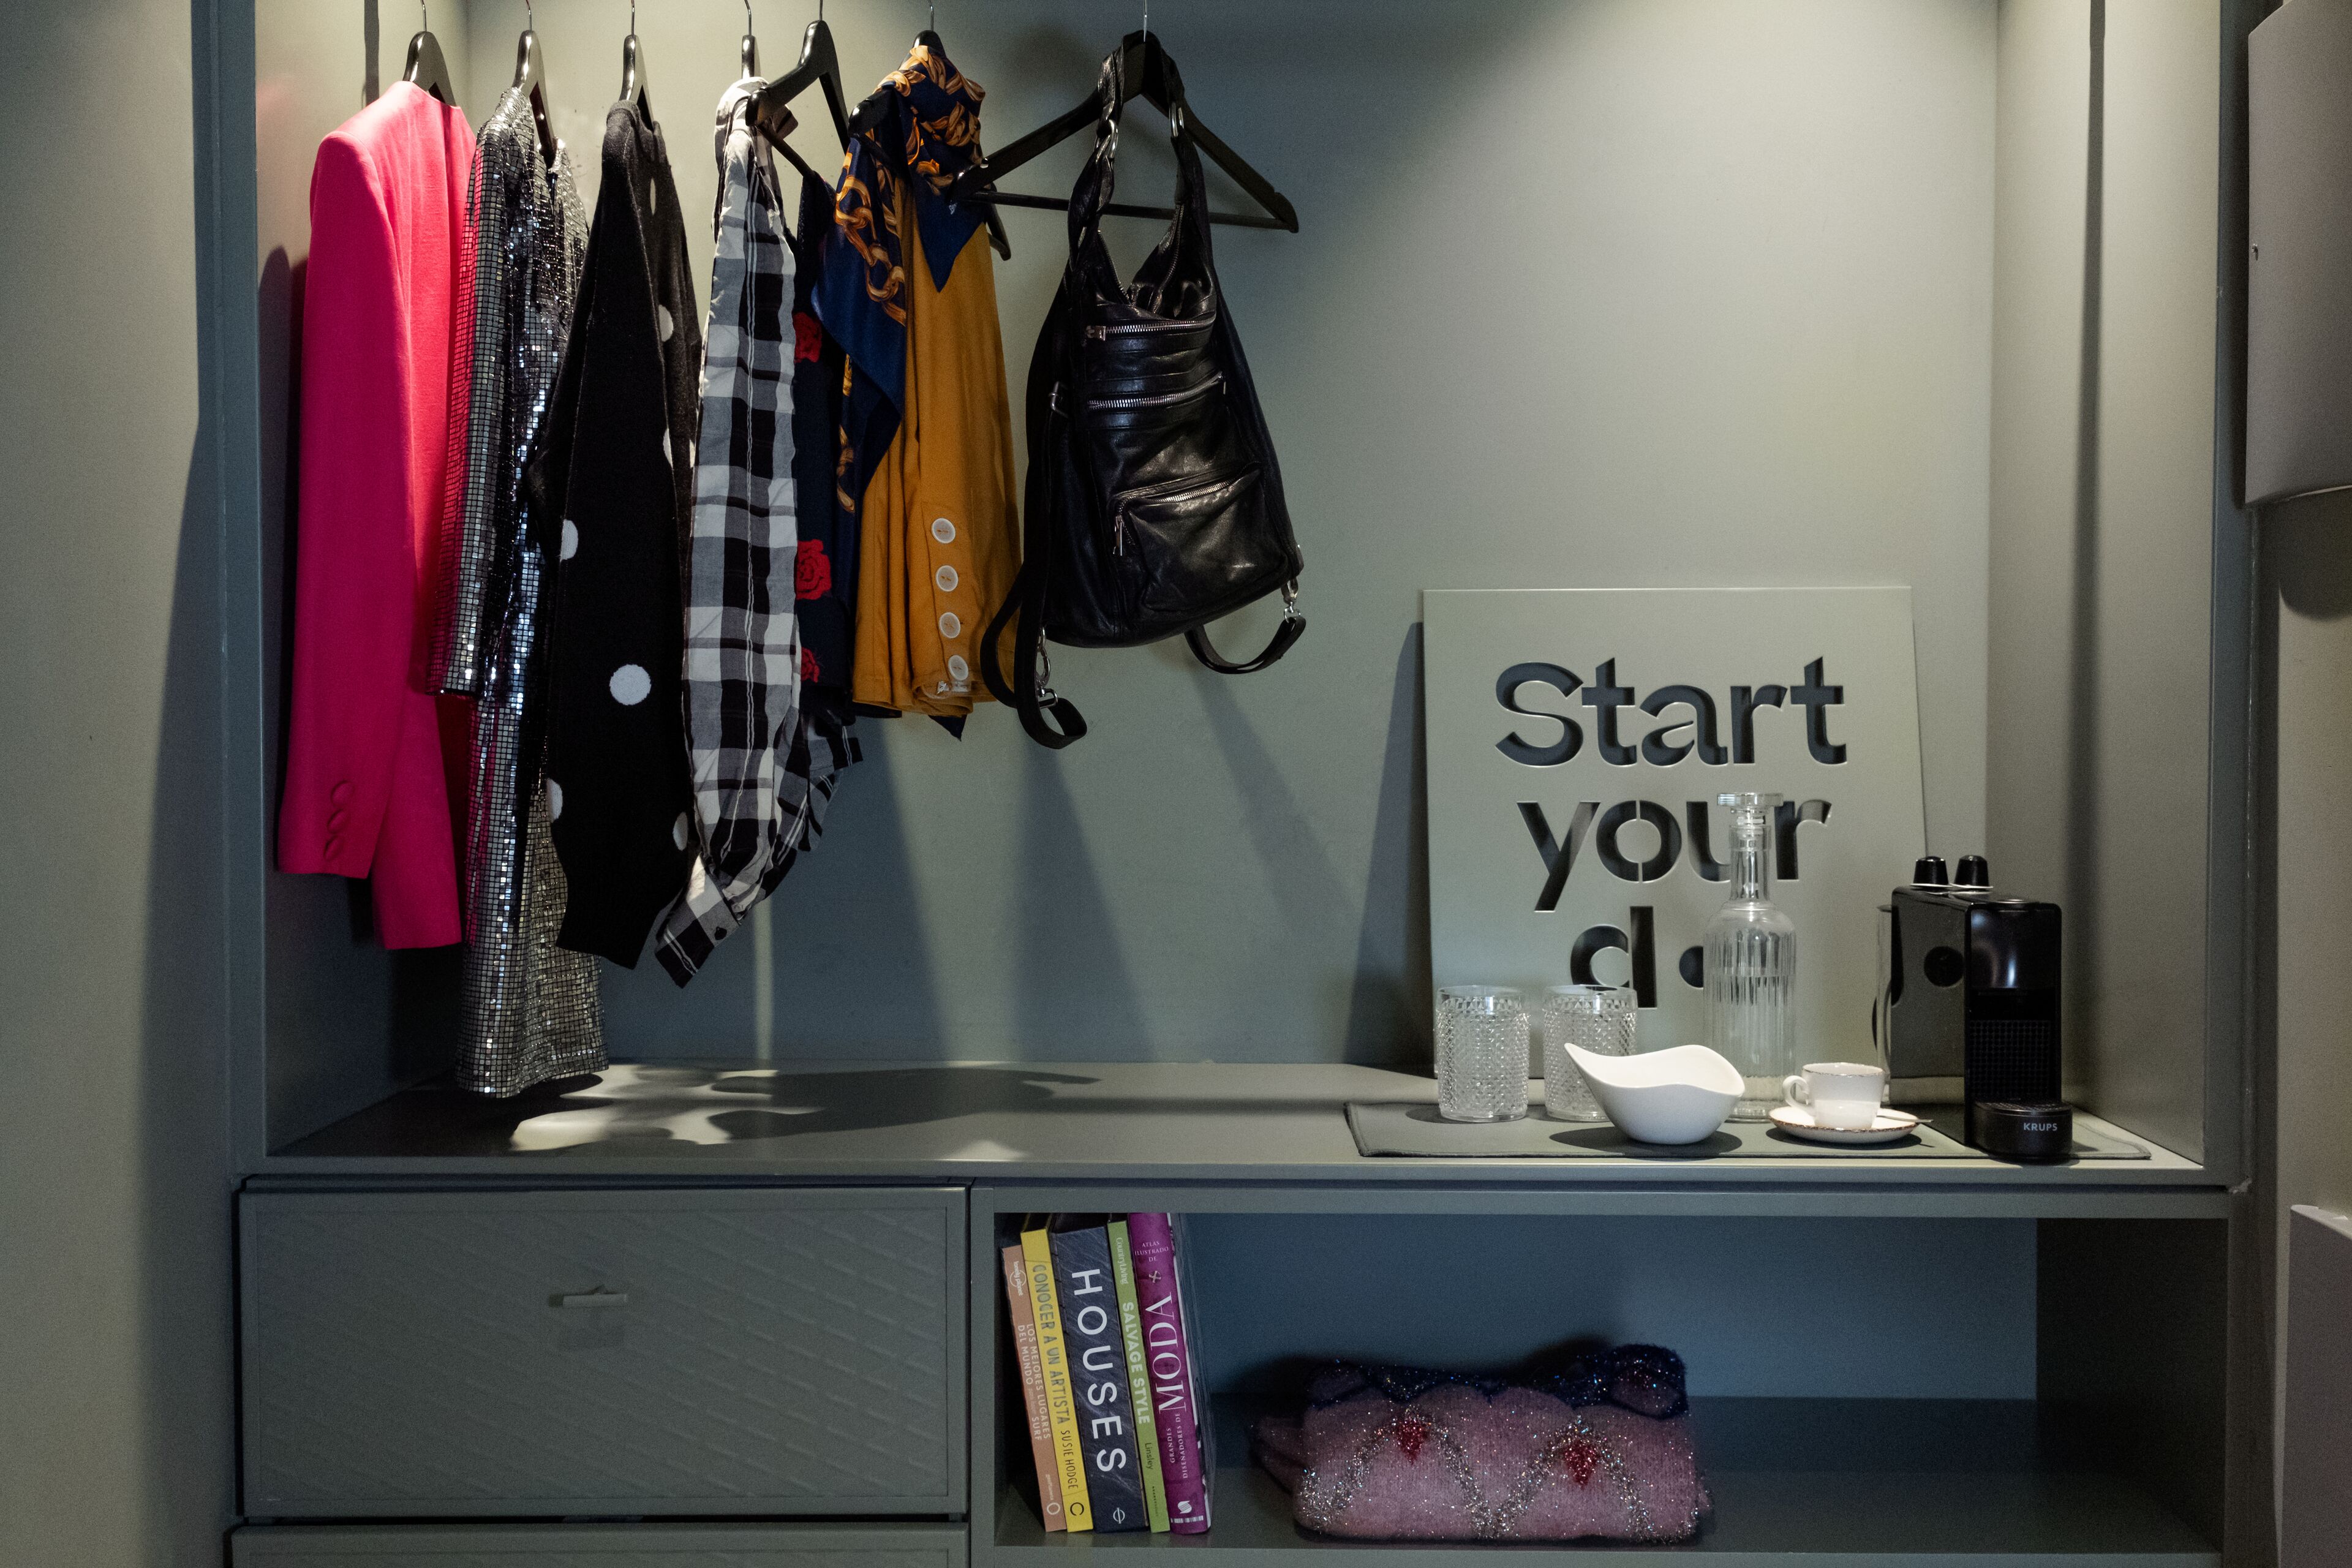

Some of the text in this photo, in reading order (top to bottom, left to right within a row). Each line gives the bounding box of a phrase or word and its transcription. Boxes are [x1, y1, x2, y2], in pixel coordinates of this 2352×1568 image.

[1495, 656, 1847, 766] Start
[1516, 799, 1833, 912] your
[2024, 1123, 2058, 1131] KRUPS
[1134, 1246, 1169, 1256] ILUSTRADO
[1021, 1346, 1033, 1385] MUNDO
[1031, 1416, 1042, 1441] SURF
[1027, 1324, 1051, 1439] LOS MEJORES LUGARES
[1033, 1264, 1071, 1424] CONOCER A UN ARTISTA
[1072, 1268, 1126, 1472] HOUSES
[1122, 1302, 1150, 1424] SALVAGE STYLE
[1145, 1291, 1186, 1414] MODA
[1060, 1430, 1079, 1489] SUSIE HODGE
[1145, 1442, 1153, 1469] Linsley
[1166, 1428, 1175, 1463] GRANDES
[1175, 1412, 1181, 1422] DE
